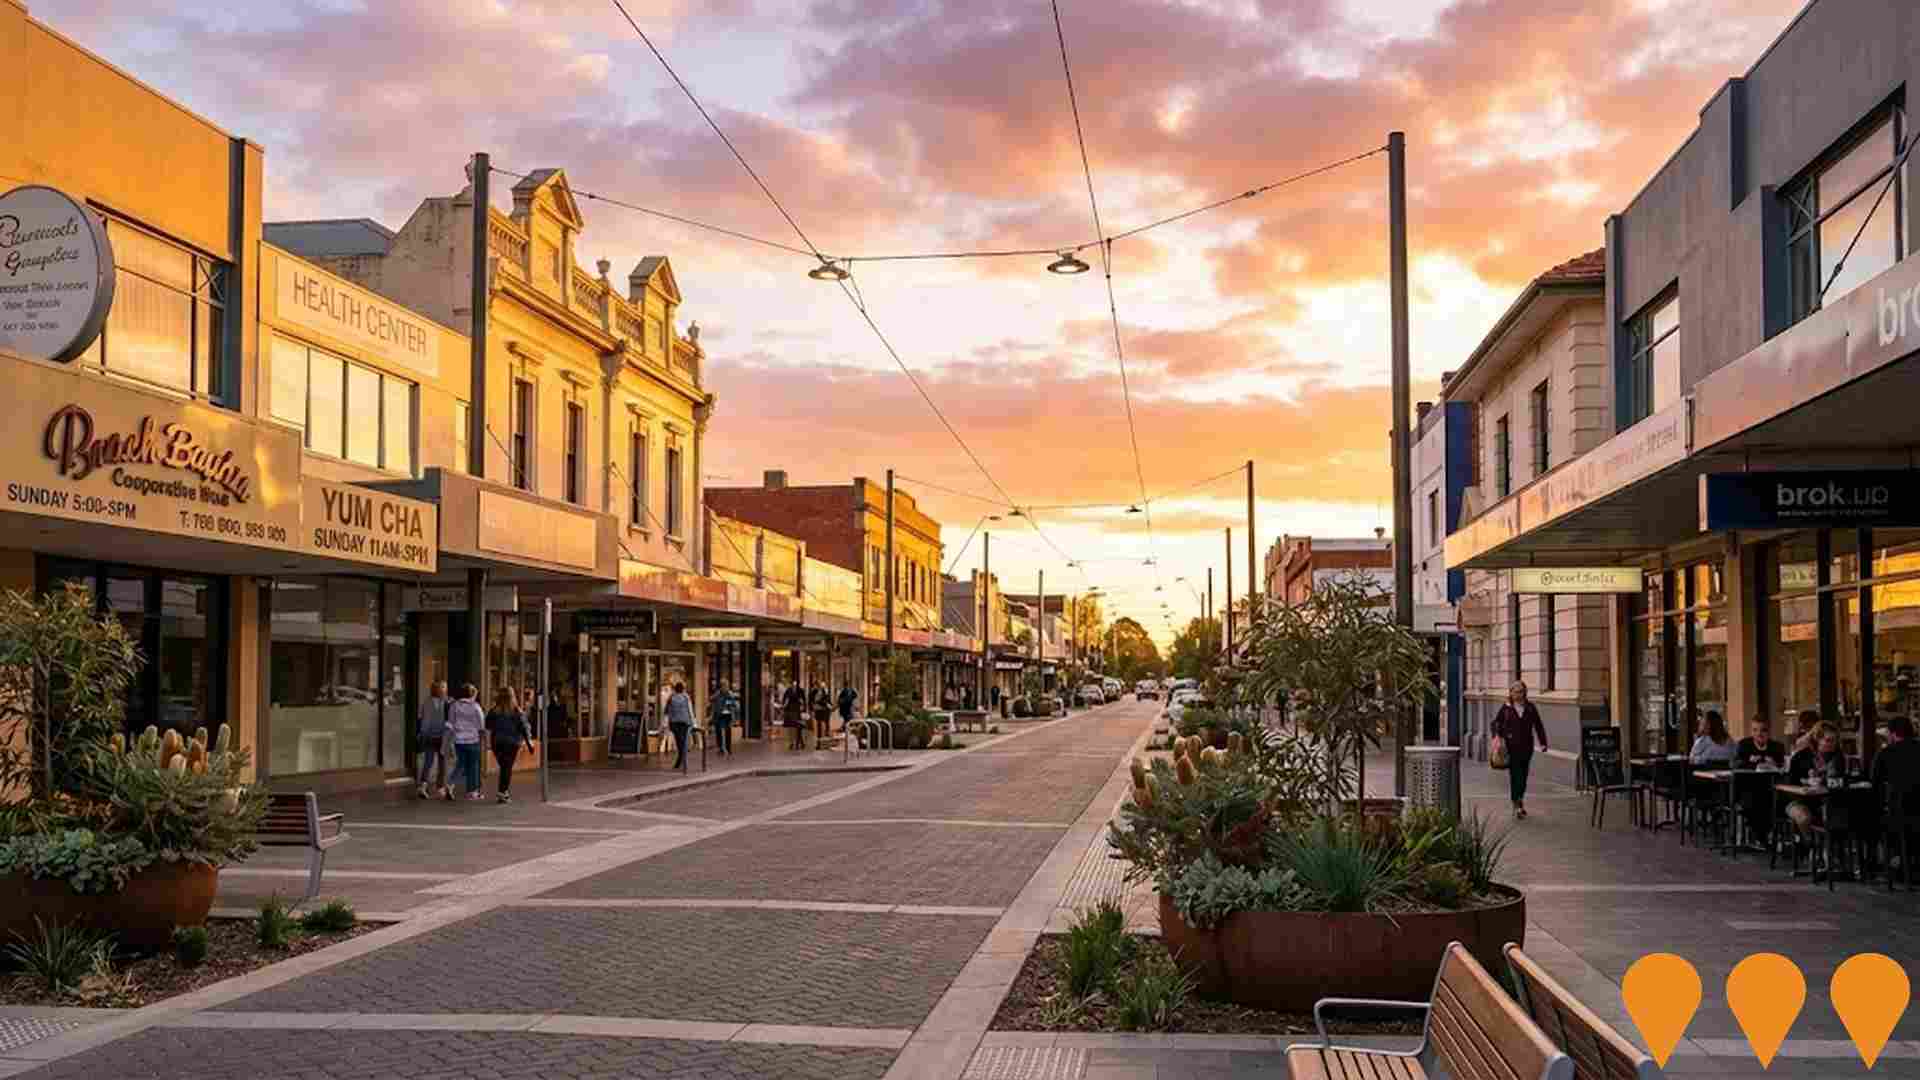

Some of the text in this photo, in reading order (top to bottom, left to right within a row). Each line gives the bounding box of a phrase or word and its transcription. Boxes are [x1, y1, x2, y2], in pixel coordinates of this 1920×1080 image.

[293, 271, 426, 354] HEALTH CENTER
[7, 483, 68, 509] SUNDAY
[322, 488, 423, 539] YUM CHA
[314, 528, 366, 553] SUNDAY
